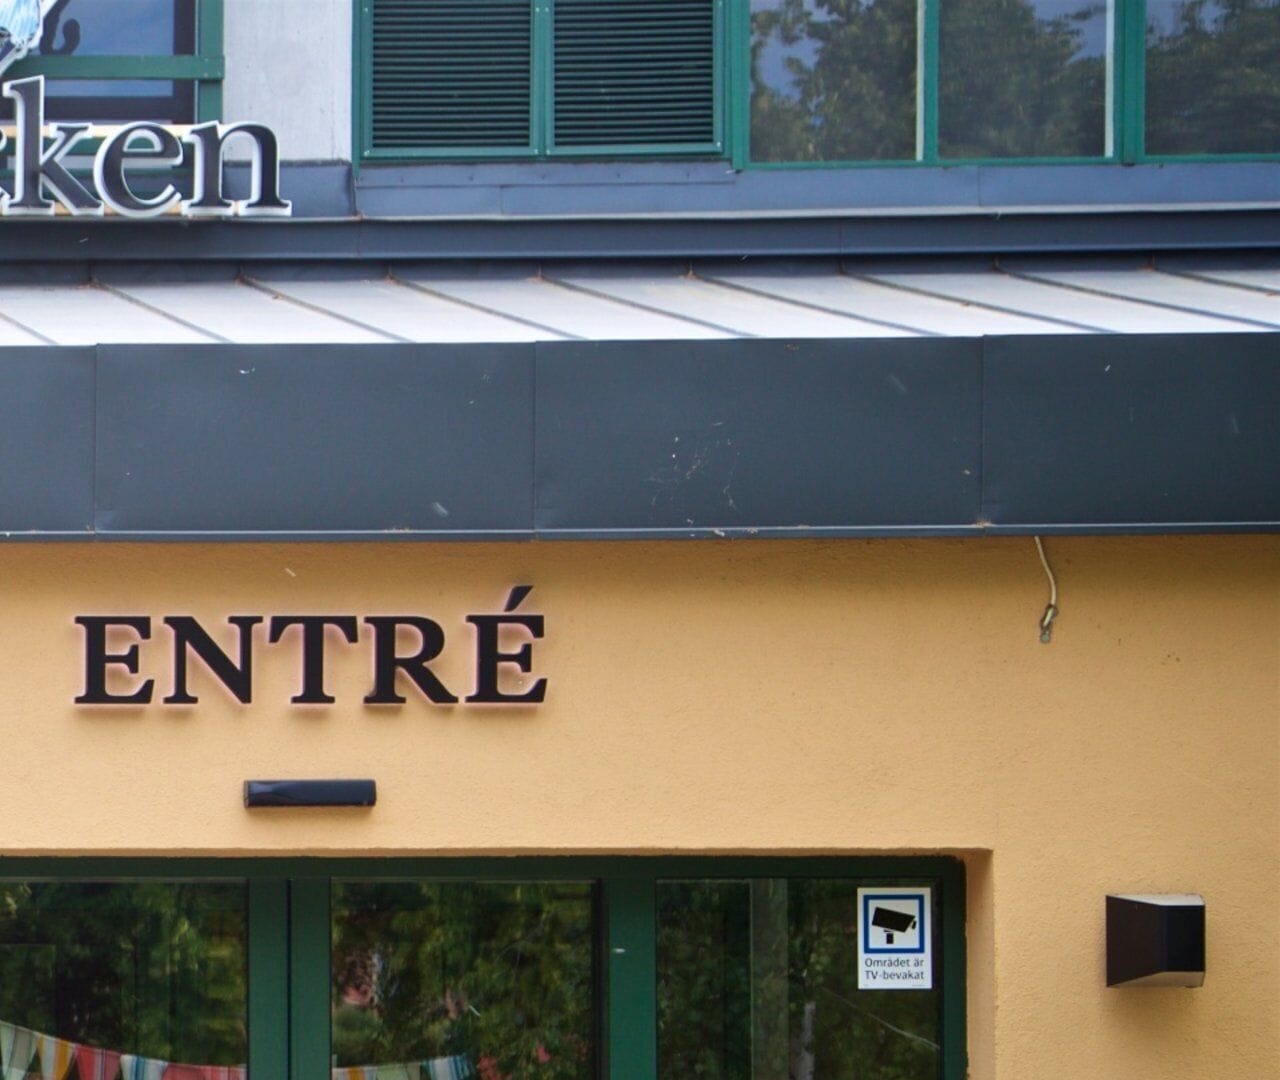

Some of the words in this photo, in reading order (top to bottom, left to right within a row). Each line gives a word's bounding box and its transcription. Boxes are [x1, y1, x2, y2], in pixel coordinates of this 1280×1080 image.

[74, 585, 548, 705] ENTRÉ
[864, 958, 910, 968] Området
[913, 958, 924, 967] är
[865, 970, 924, 980] TV-bevakat
